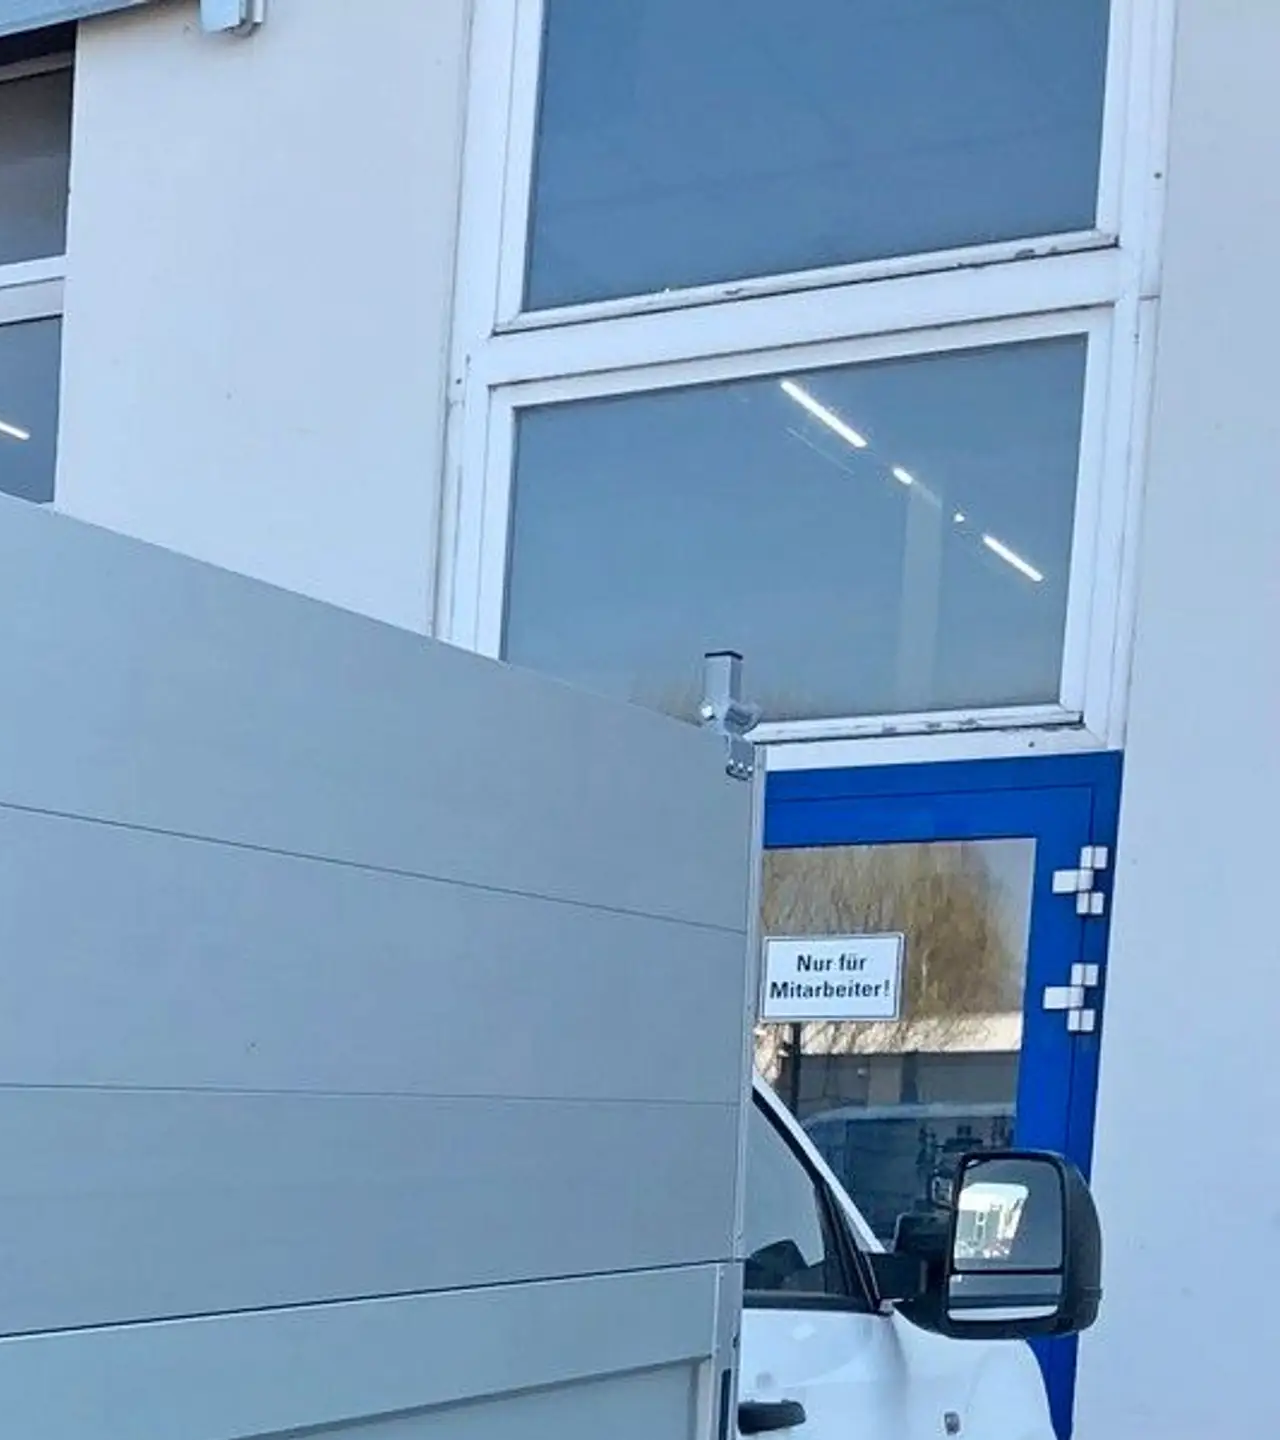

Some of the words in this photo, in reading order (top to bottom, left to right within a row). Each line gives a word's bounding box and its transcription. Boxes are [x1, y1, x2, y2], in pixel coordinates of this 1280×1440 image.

[796, 953, 836, 972] Nur
[839, 952, 868, 972] für
[769, 979, 891, 1000] Mitarbeiter!
